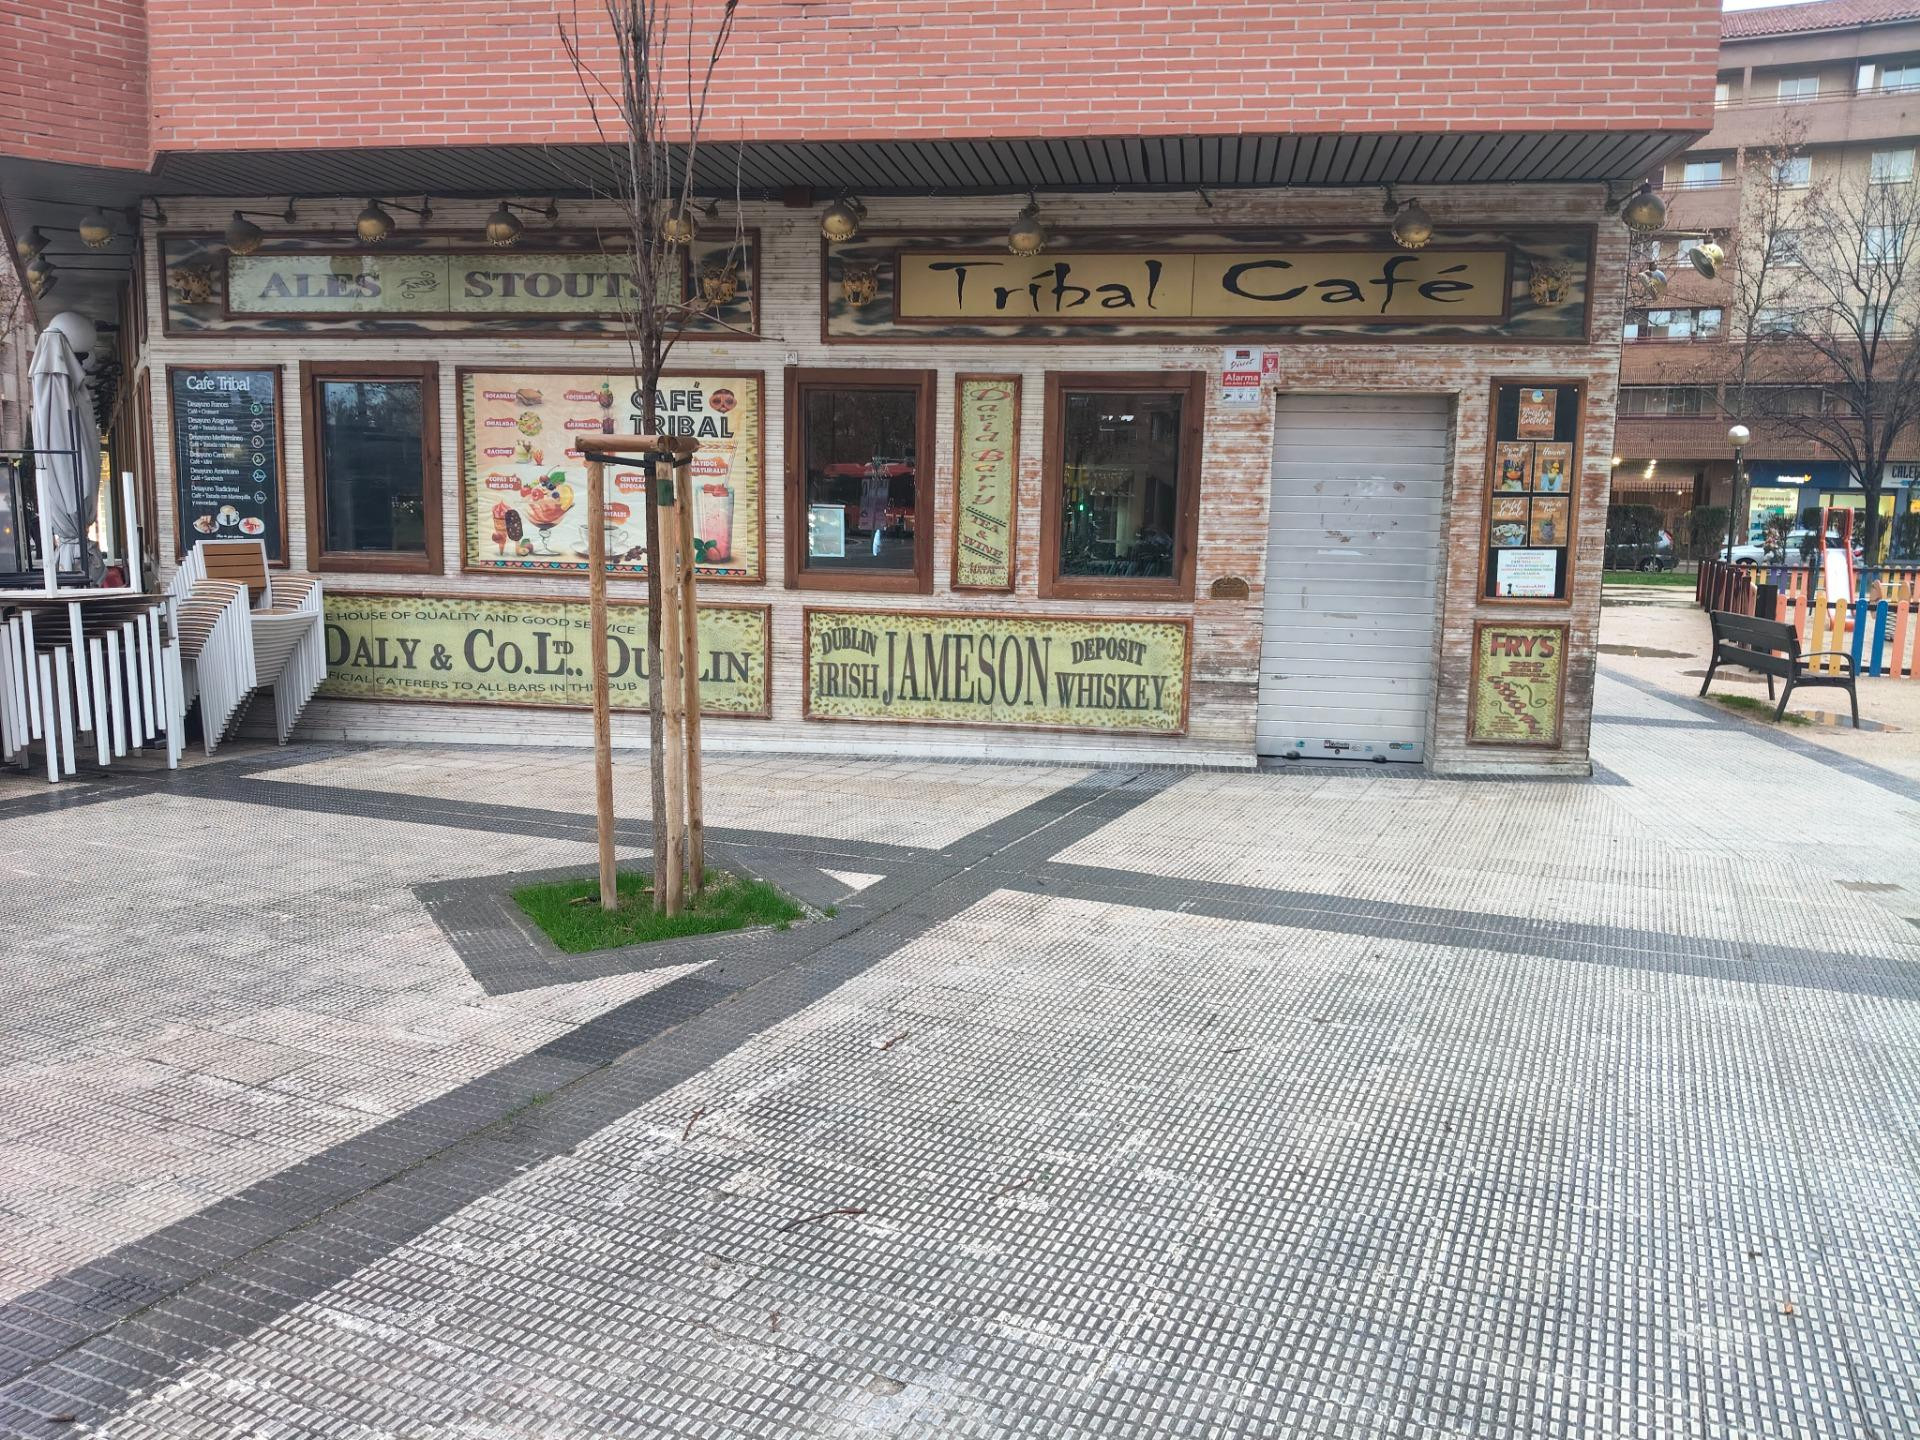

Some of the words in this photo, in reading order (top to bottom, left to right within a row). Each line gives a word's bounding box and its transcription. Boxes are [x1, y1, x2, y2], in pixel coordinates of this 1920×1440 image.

[258, 271, 383, 298] ALES
[1221, 255, 1475, 314] Café
[217, 376, 250, 391] Tribal
[1224, 373, 1259, 382] Alarma
[970, 515, 1000, 535] TEA
[975, 529, 988, 541] &
[963, 534, 1004, 559] WINE
[337, 611, 387, 621] HOUSE
[391, 611, 412, 620] OF
[415, 611, 480, 622] QUALITY
[484, 613, 518, 623] AND
[522, 616, 570, 627] GOOD
[574, 619, 636, 635] SEICE
[324, 623, 422, 669] DALY
[430, 643, 453, 671] &
[607, 634, 752, 684] DUIN
[820, 626, 880, 657] DUBLIN
[1071, 636, 1148, 667] DEPOSIT
[327, 670, 372, 684] FICIAL
[376, 676, 449, 690] CATERERS
[452, 681, 474, 691] TO
[477, 682, 507, 692] ALL
[508, 683, 546, 692] BARS
[550, 683, 566, 692] IN
[567, 683, 594, 693] TH
[607, 682, 638, 692] PUB
[815, 661, 880, 701] IRISH
[882, 630, 1053, 708] JAMESON
[1054, 670, 1170, 711] WHISKEY
